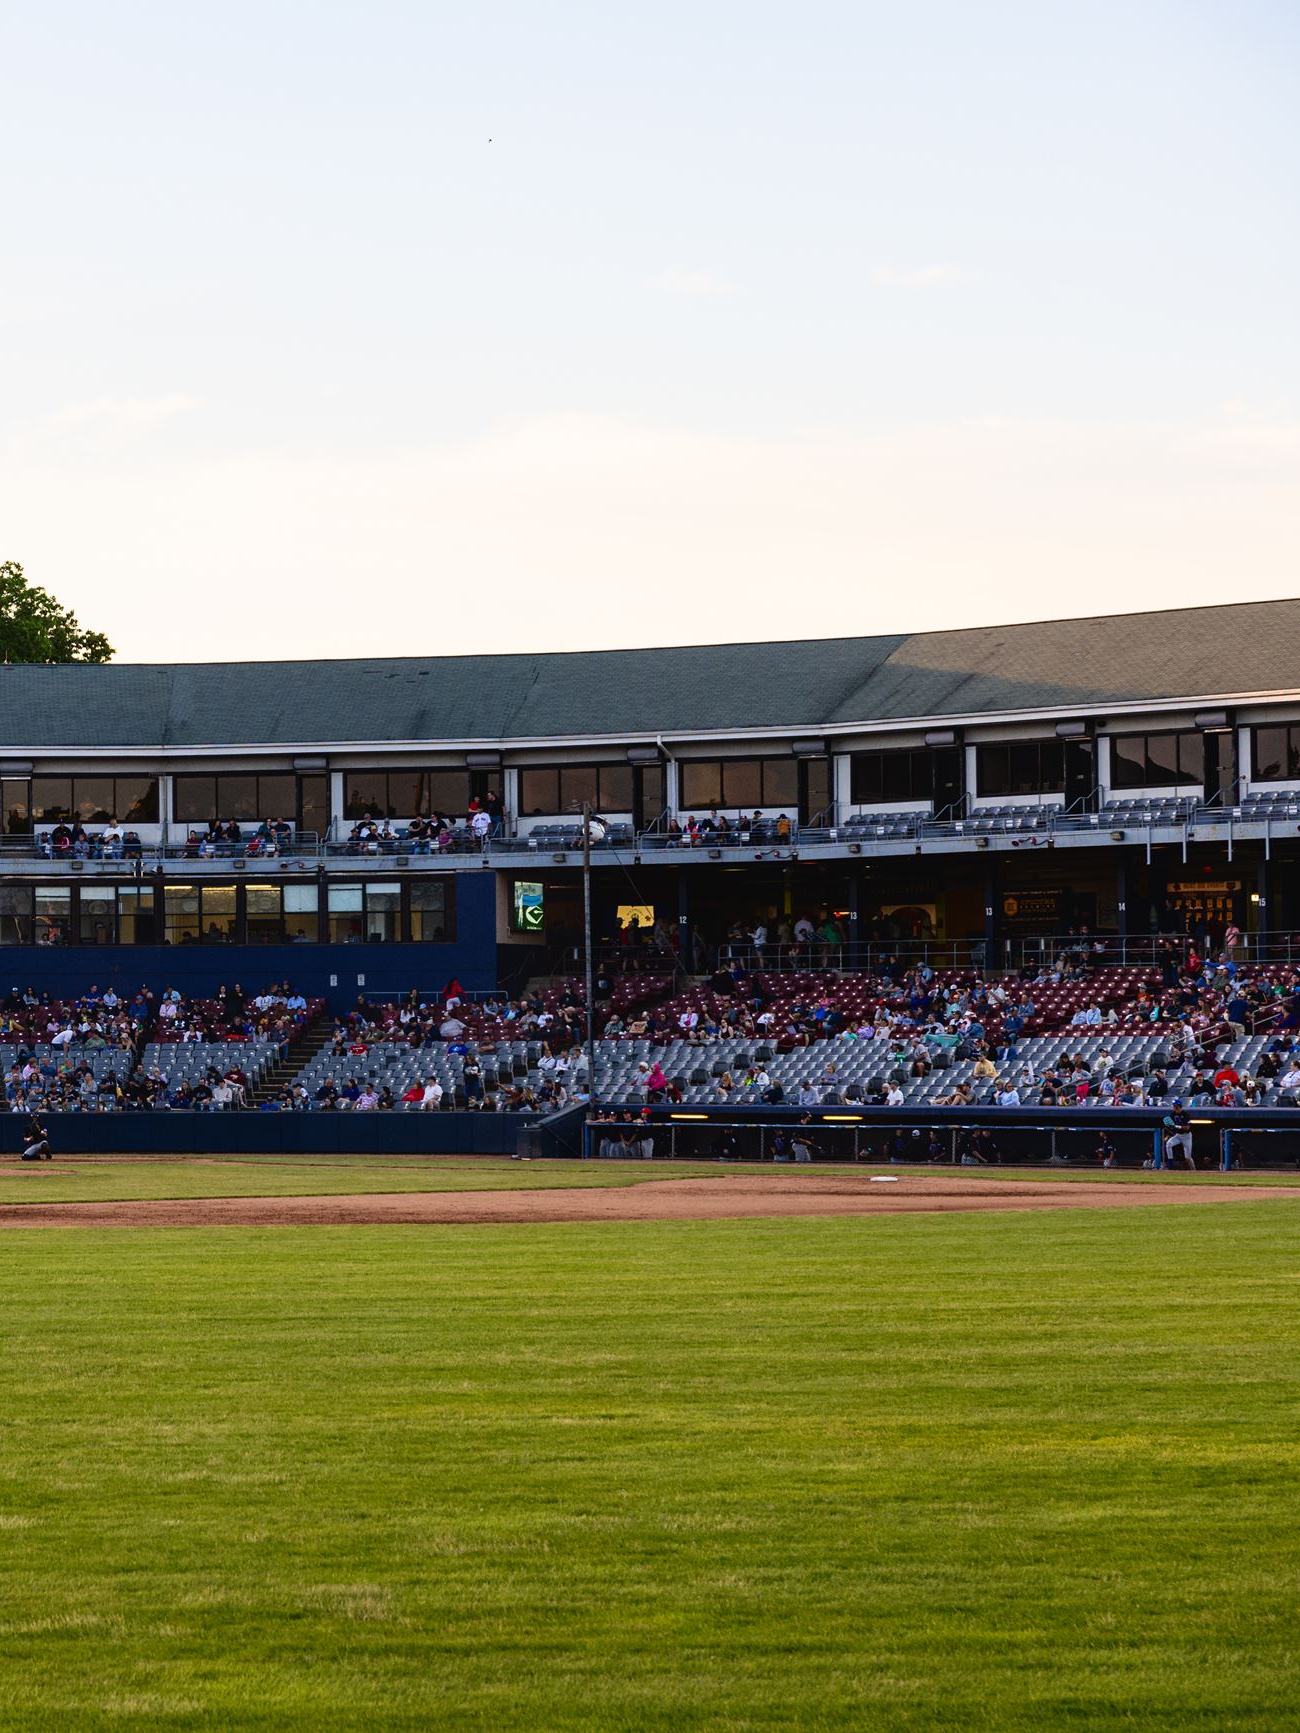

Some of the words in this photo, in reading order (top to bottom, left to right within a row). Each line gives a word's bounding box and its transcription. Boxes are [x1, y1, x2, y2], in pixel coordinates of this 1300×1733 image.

[1118, 902, 1126, 911] 14
[850, 911, 857, 920] 13
[985, 907, 993, 916] 13
[679, 915, 687, 924] 12
